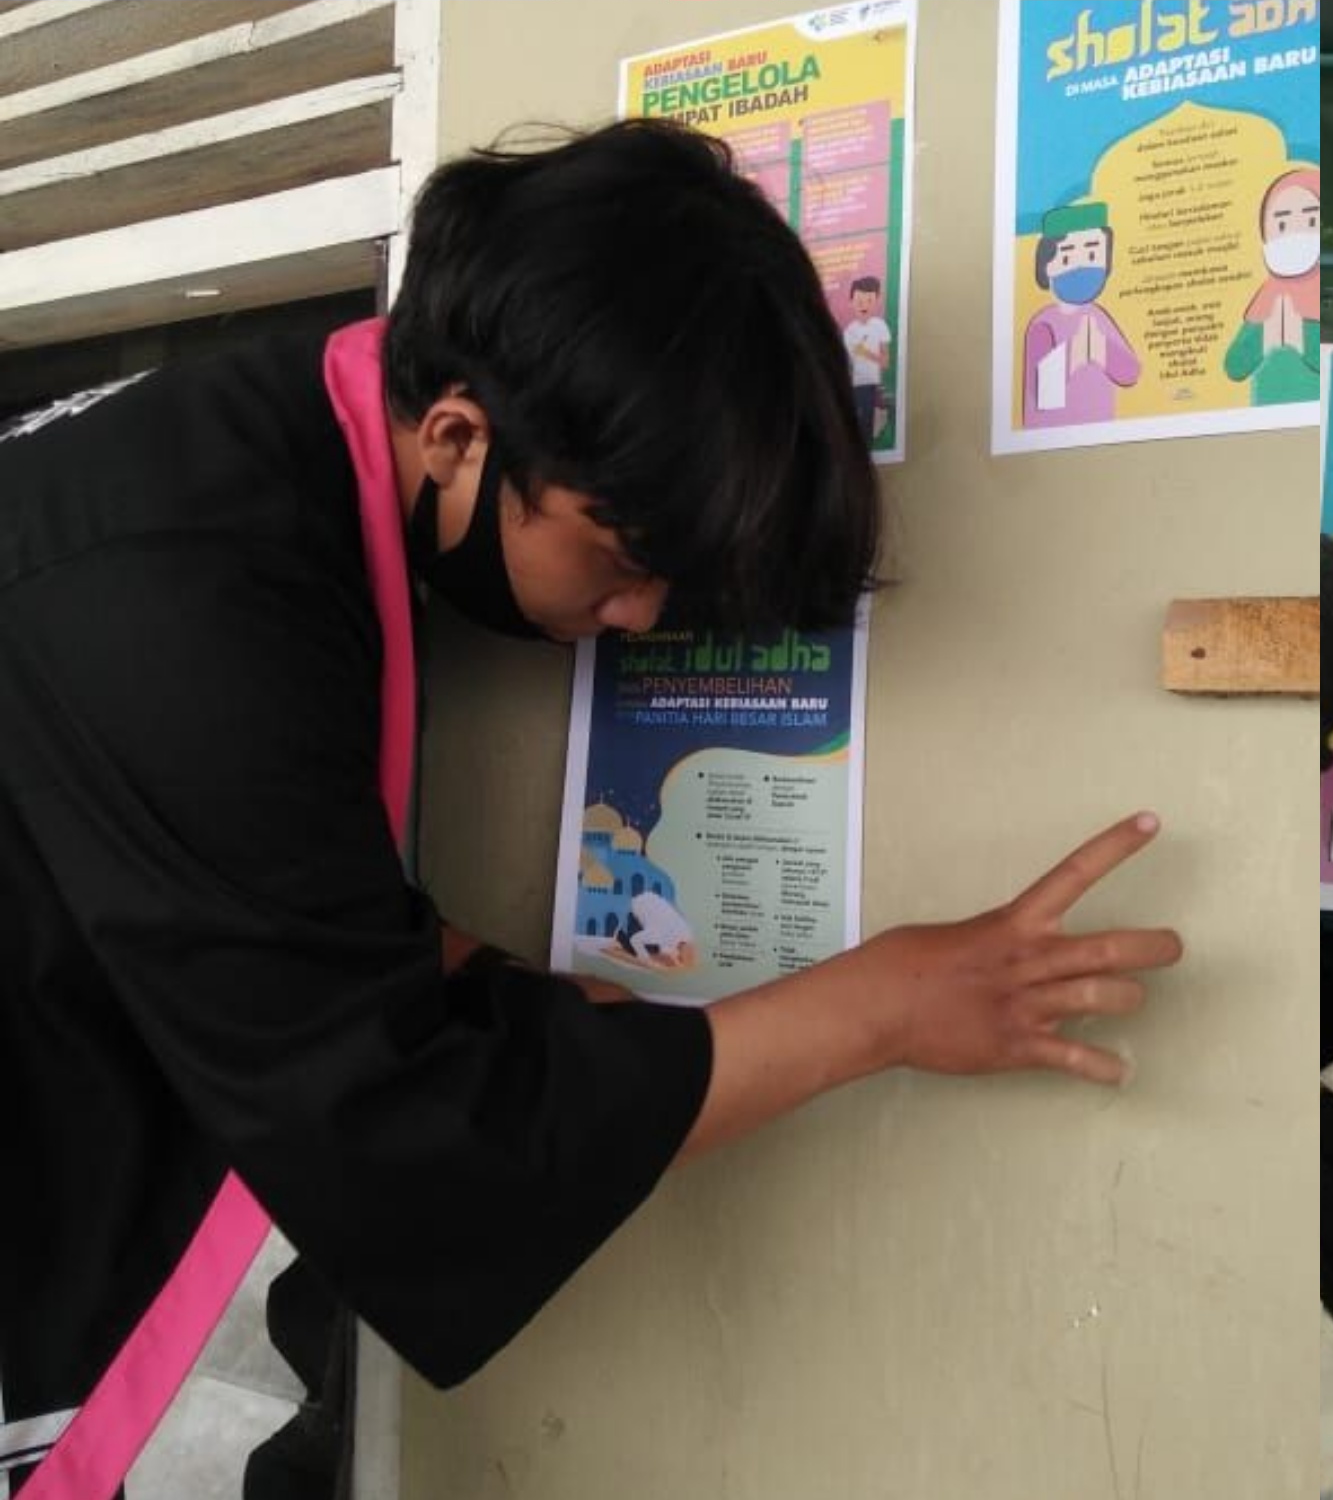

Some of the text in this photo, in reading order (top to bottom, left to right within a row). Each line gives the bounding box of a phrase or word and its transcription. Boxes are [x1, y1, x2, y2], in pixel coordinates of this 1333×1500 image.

[1047, 0, 1218, 82] sholat
[643, 50, 711, 77] ADAPTASI
[727, 51, 768, 71] BARU
[1122, 45, 1317, 100] KEBIASAAN BARU
[1125, 46, 1231, 82] ADAPTASI
[642, 54, 821, 118] PENGELOLA
[729, 85, 809, 118] IBADAH
[751, 628, 831, 672] adha
[642, 677, 793, 694] PENYEMBELIHAN
[692, 711, 728, 725] HARI
[780, 712, 828, 727] ISLAM
[791, 698, 829, 710] BARU
